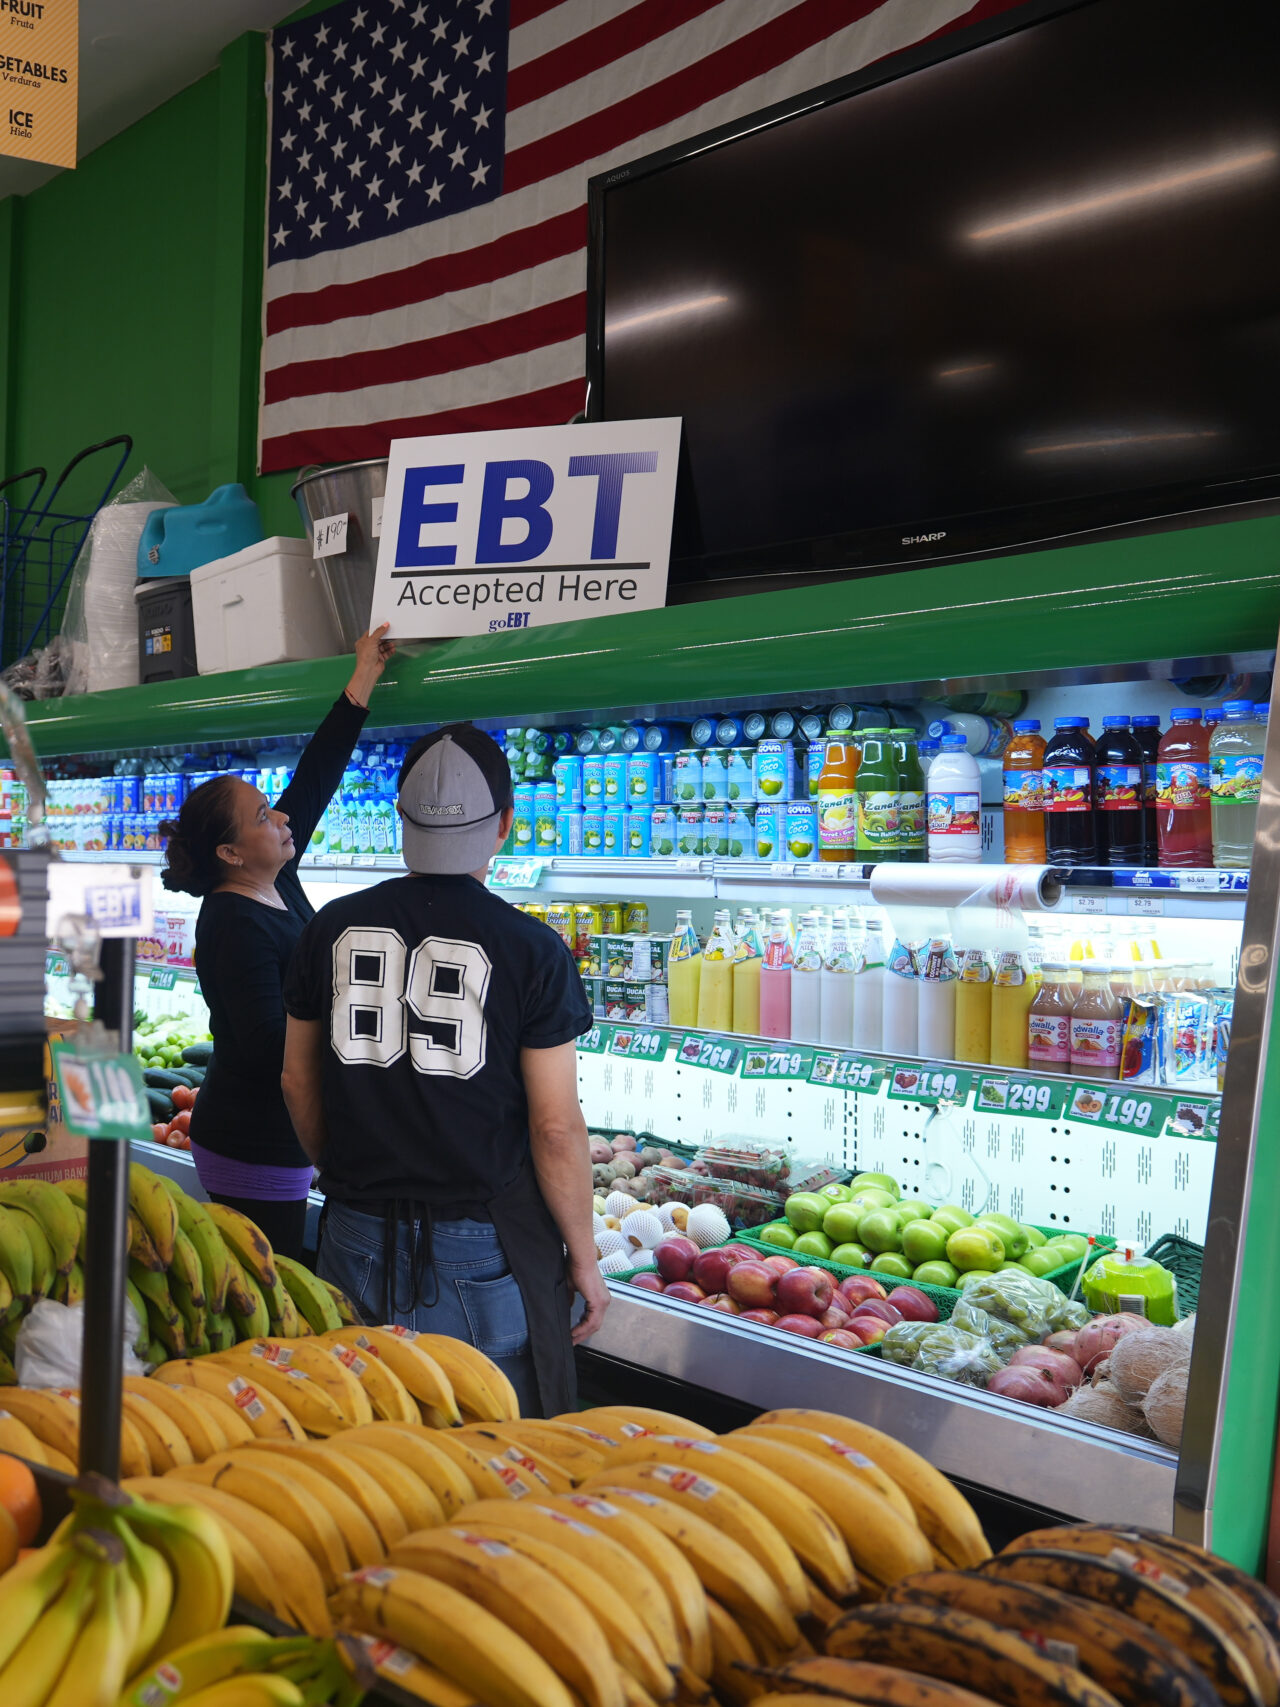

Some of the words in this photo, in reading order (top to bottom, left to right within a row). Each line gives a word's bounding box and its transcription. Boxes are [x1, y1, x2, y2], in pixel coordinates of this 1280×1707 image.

[0, 0, 45, 20] FRUIT
[10, 16, 35, 30] Fruta
[1, 72, 42, 89] Verduras
[9, 109, 34, 128] ICE
[10, 126, 32, 139] Hielo
[394, 451, 659, 568] EBT
[902, 532, 947, 545] SHARP
[397, 574, 545, 610] Accepted
[558, 575, 638, 602] Here
[489, 611, 531, 633] goEBT
[758, 744, 782, 753] GOYA
[787, 806, 812, 814] GOYA
[91, 888, 137, 919] EBT
[331, 926, 494, 1081] 89
[1073, 1025, 1105, 1035] odwalla
[631, 1033, 661, 1055] 299
[699, 1044, 732, 1069] 269
[768, 1053, 801, 1074] 269
[834, 1061, 873, 1087] 159
[918, 1072, 957, 1098] 199
[1009, 1084, 1051, 1112] 299
[1105, 1097, 1152, 1128] 199
